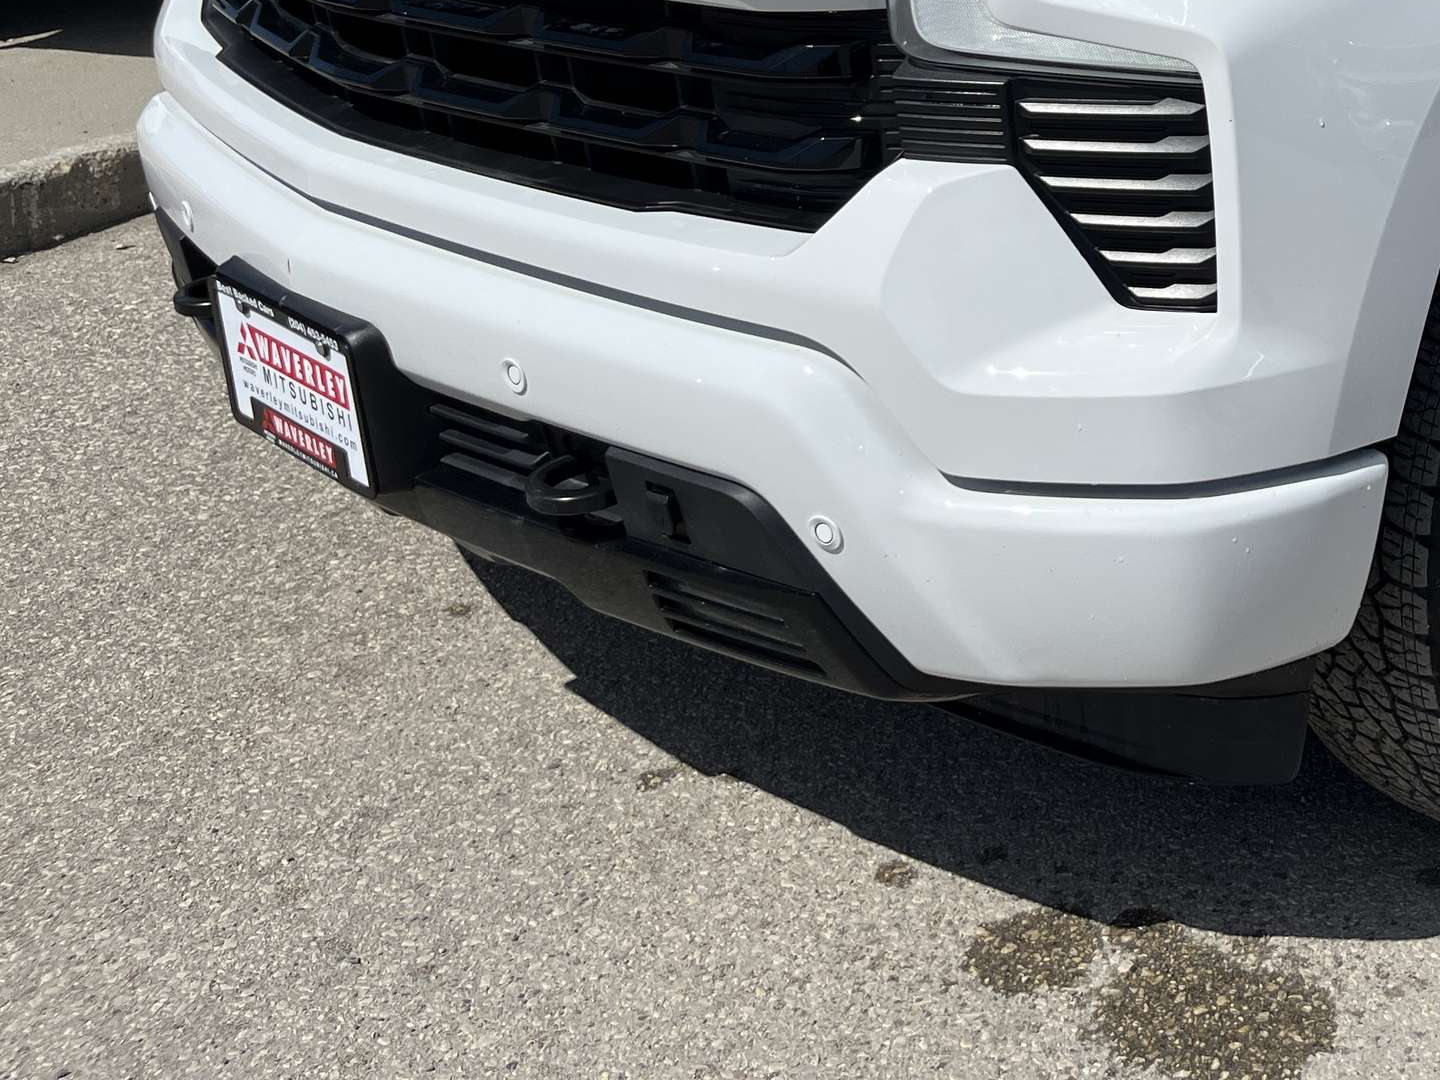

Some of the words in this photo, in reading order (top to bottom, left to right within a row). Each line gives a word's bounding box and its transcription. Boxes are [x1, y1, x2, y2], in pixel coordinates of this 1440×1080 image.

[254, 331, 347, 404] WAVERLEY
[262, 366, 353, 432] MITSUBISHI
[242, 379, 358, 452] waverleymitsubishi.com
[272, 414, 334, 464] WAVERLEY
